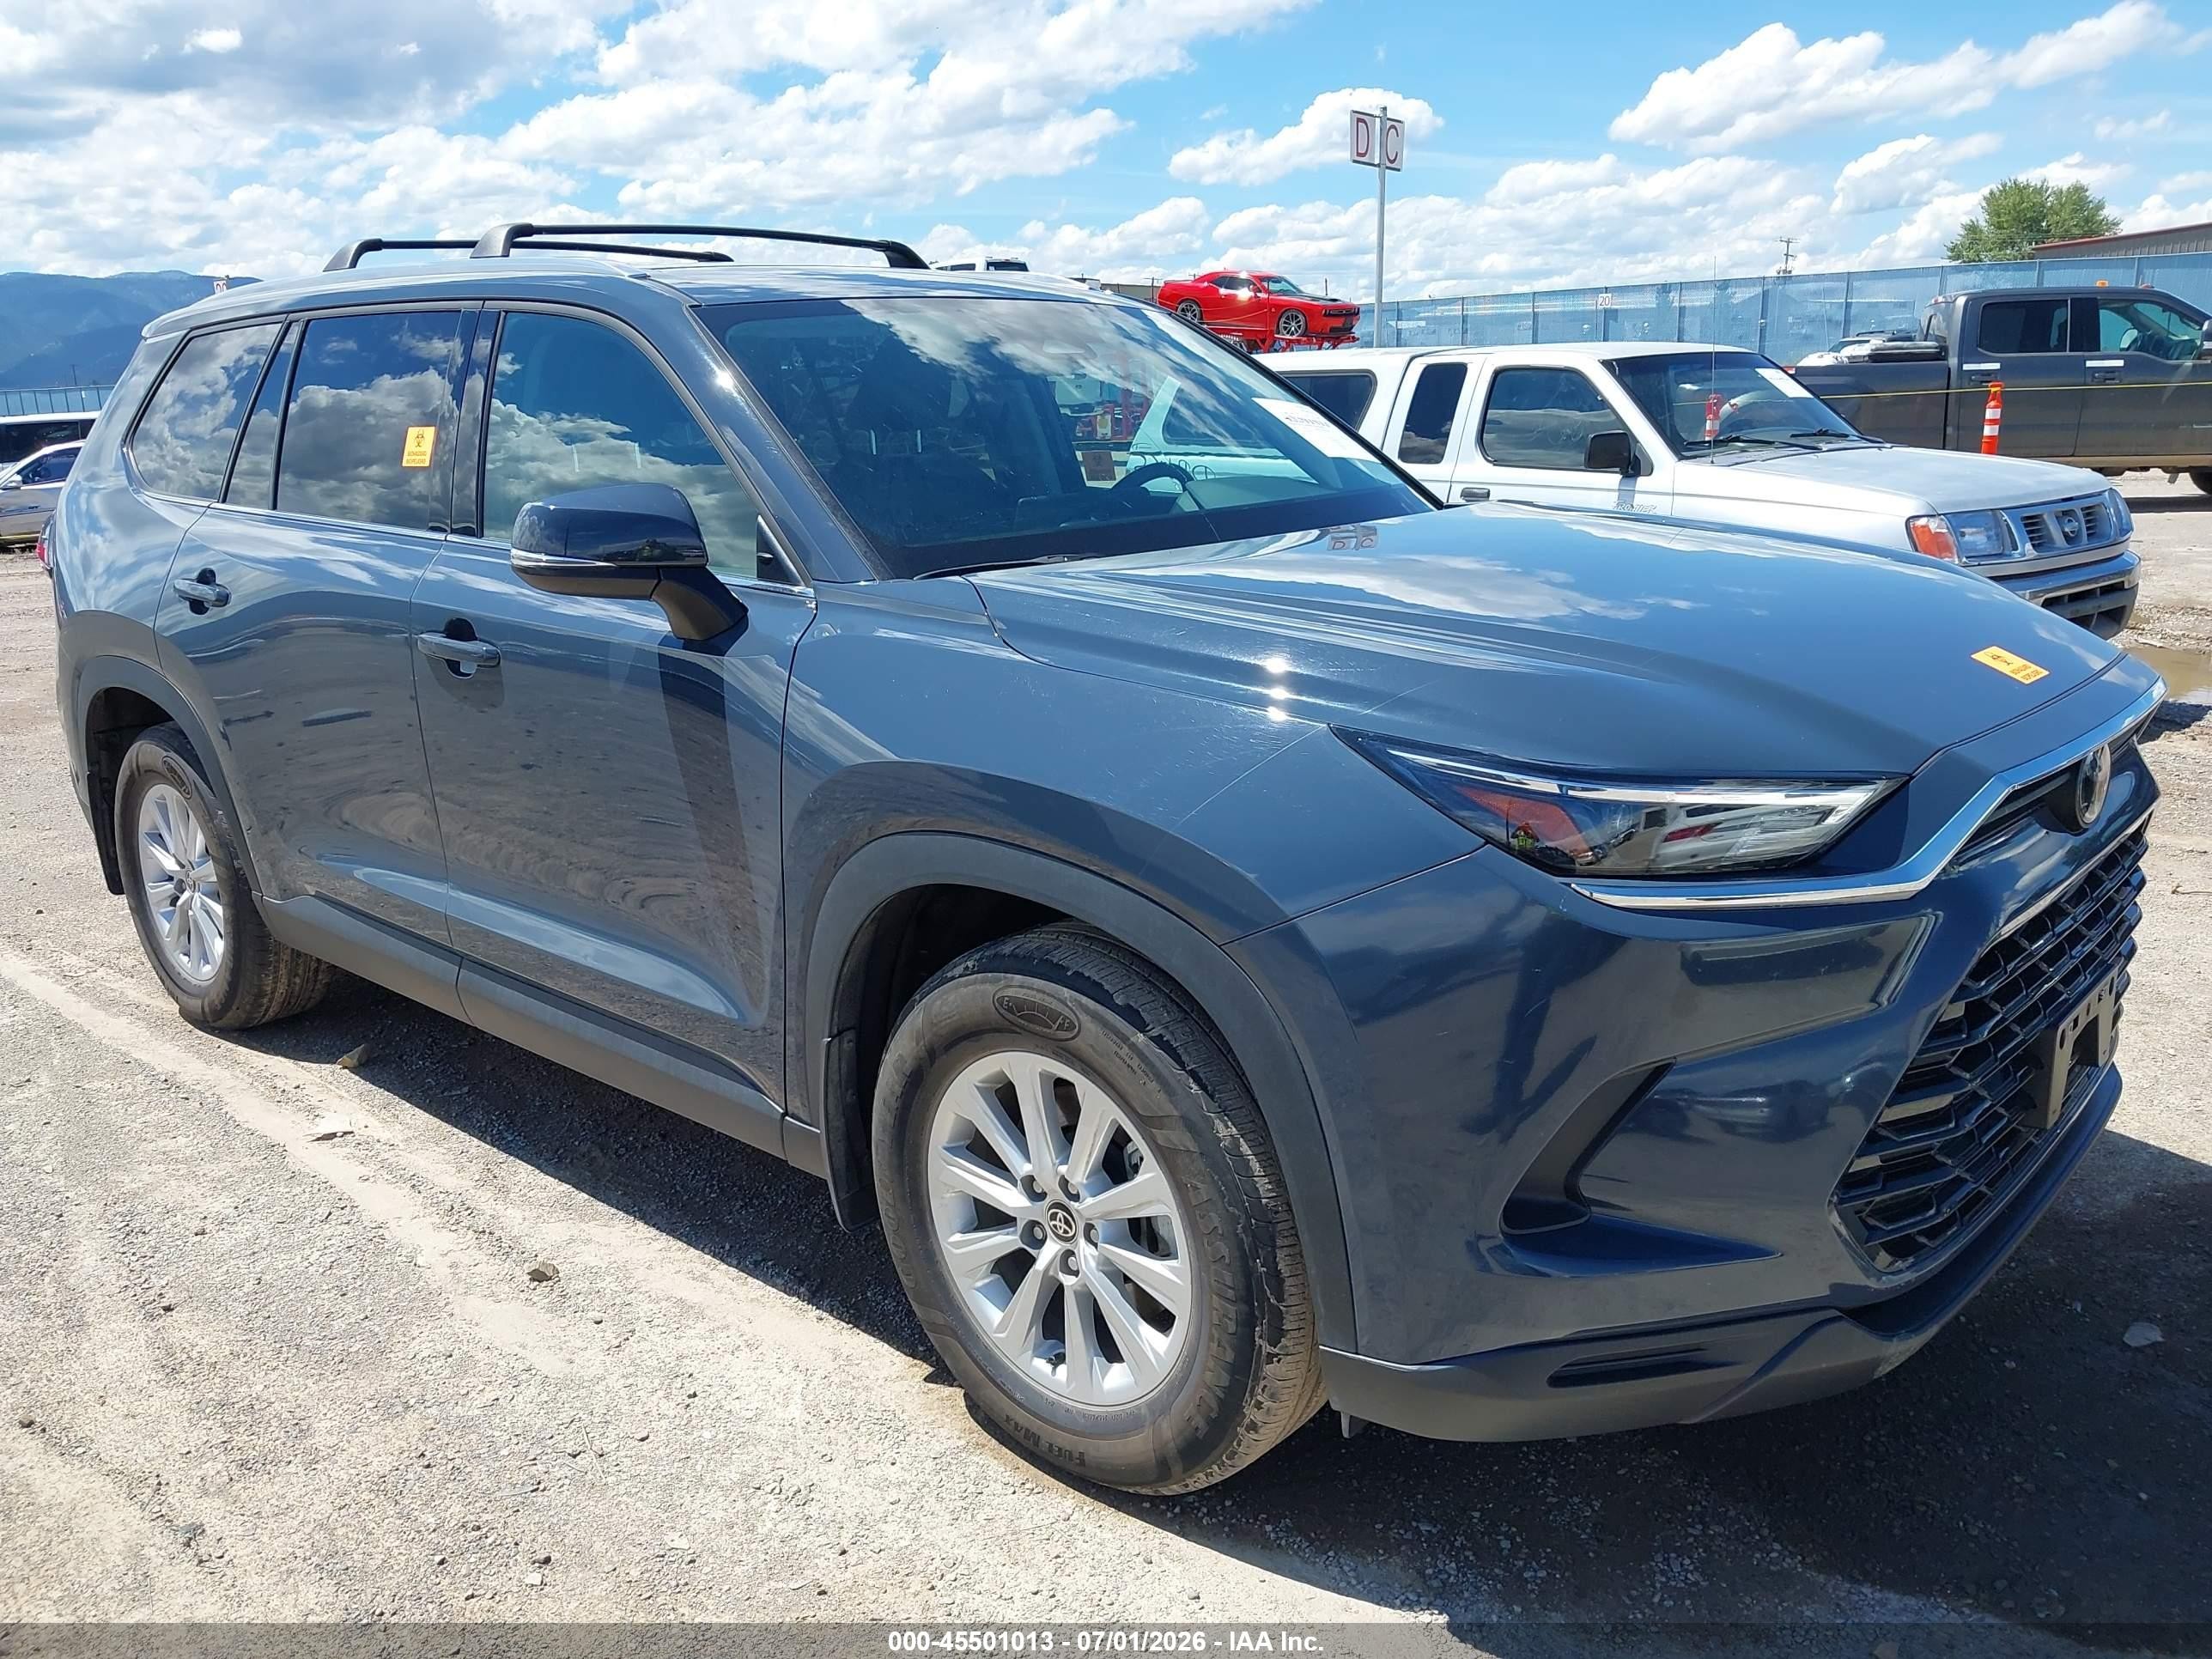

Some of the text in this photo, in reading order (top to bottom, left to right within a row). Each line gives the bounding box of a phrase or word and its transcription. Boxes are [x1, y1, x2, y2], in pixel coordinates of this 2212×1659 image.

[1356, 117, 1400, 165] D C
[1599, 295, 1610, 307] 20
[1185, 1176, 1238, 1441] ASSURANCE
